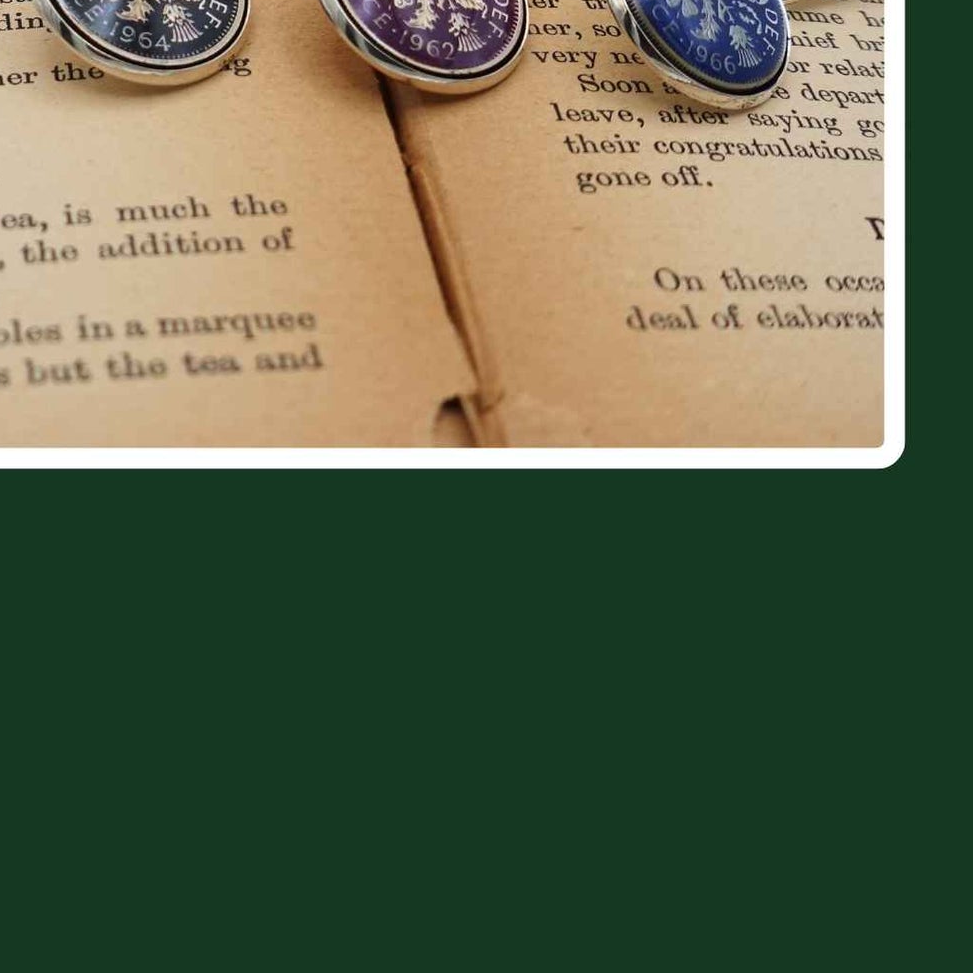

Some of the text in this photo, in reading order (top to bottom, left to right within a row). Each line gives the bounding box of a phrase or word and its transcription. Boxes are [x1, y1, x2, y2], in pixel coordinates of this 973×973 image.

[109, 21, 172, 52] 1964
[399, 29, 455, 61] 1962
[593, 24, 621, 38] so
[50, 62, 105, 82] the
[531, 50, 598, 69] very
[685, 40, 737, 75] 1966
[577, 74, 654, 94] Soon
[550, 103, 840, 136] leave, after saying
[563, 135, 884, 162] their congratulations
[576, 165, 714, 193] gone off.
[63, 204, 92, 226] is
[116, 196, 211, 223] much
[230, 194, 288, 216] the
[21, 240, 79, 265] the
[98, 231, 246, 260] addition
[261, 227, 296, 252] of
[654, 267, 808, 292] On these
[77, 314, 115, 341] in
[124, 317, 147, 338] a
[157, 309, 317, 341] marquee
[625, 303, 744, 331] deal of
[24, 357, 91, 386] but
[106, 351, 168, 380] the
[182, 350, 240, 375] tea
[254, 343, 325, 371] and
